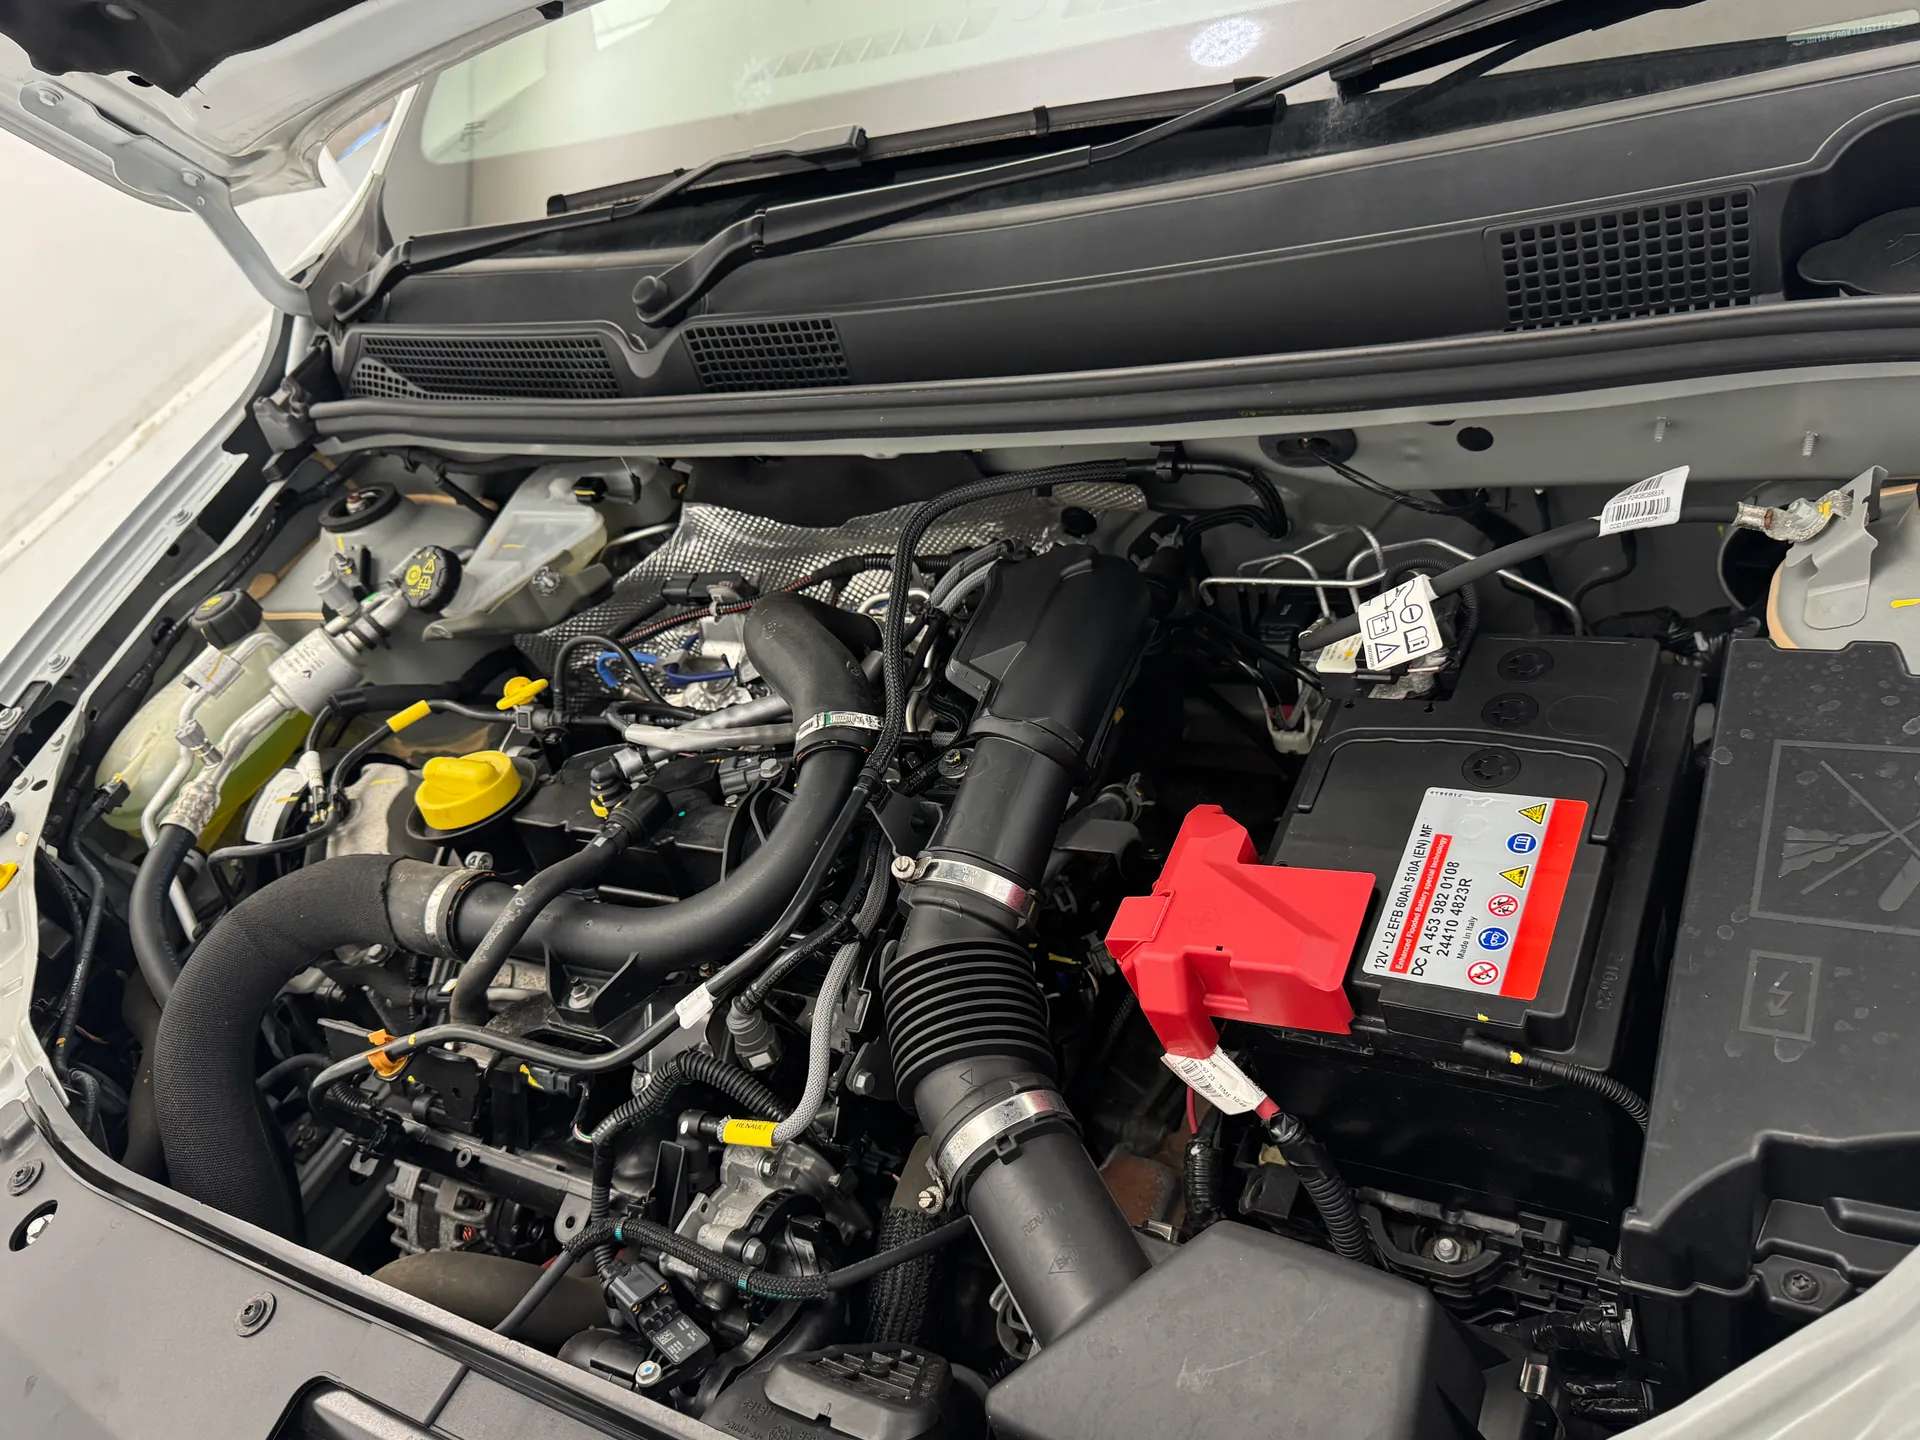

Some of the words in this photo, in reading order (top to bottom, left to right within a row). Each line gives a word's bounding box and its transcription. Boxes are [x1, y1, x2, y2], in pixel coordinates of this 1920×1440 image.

[1419, 823, 1433, 837] MF
[1411, 839, 1429, 858] (EN)
[1429, 836, 1448, 867] technology
[1403, 859, 1421, 881] 510A
[1421, 868, 1437, 890] special
[1439, 861, 1459, 889] 0108
[1394, 884, 1413, 907] 60Ah
[1414, 890, 1430, 912] Battery
[1431, 893, 1449, 914] 982
[1387, 910, 1404, 929] EFB
[1405, 913, 1421, 937] Flooded
[1436, 919, 1459, 956] 24410
[1449, 877, 1472, 916] 4823R
[1382, 931, 1396, 943] L2
[1422, 918, 1441, 939] 453
[1456, 940, 1468, 958] Made
[1465, 915, 1477, 931] Italy
[1373, 950, 1390, 969] 12V
[1395, 938, 1412, 969] Enhanced
[1418, 944, 1432, 953] A
[1410, 957, 1428, 976] DC
